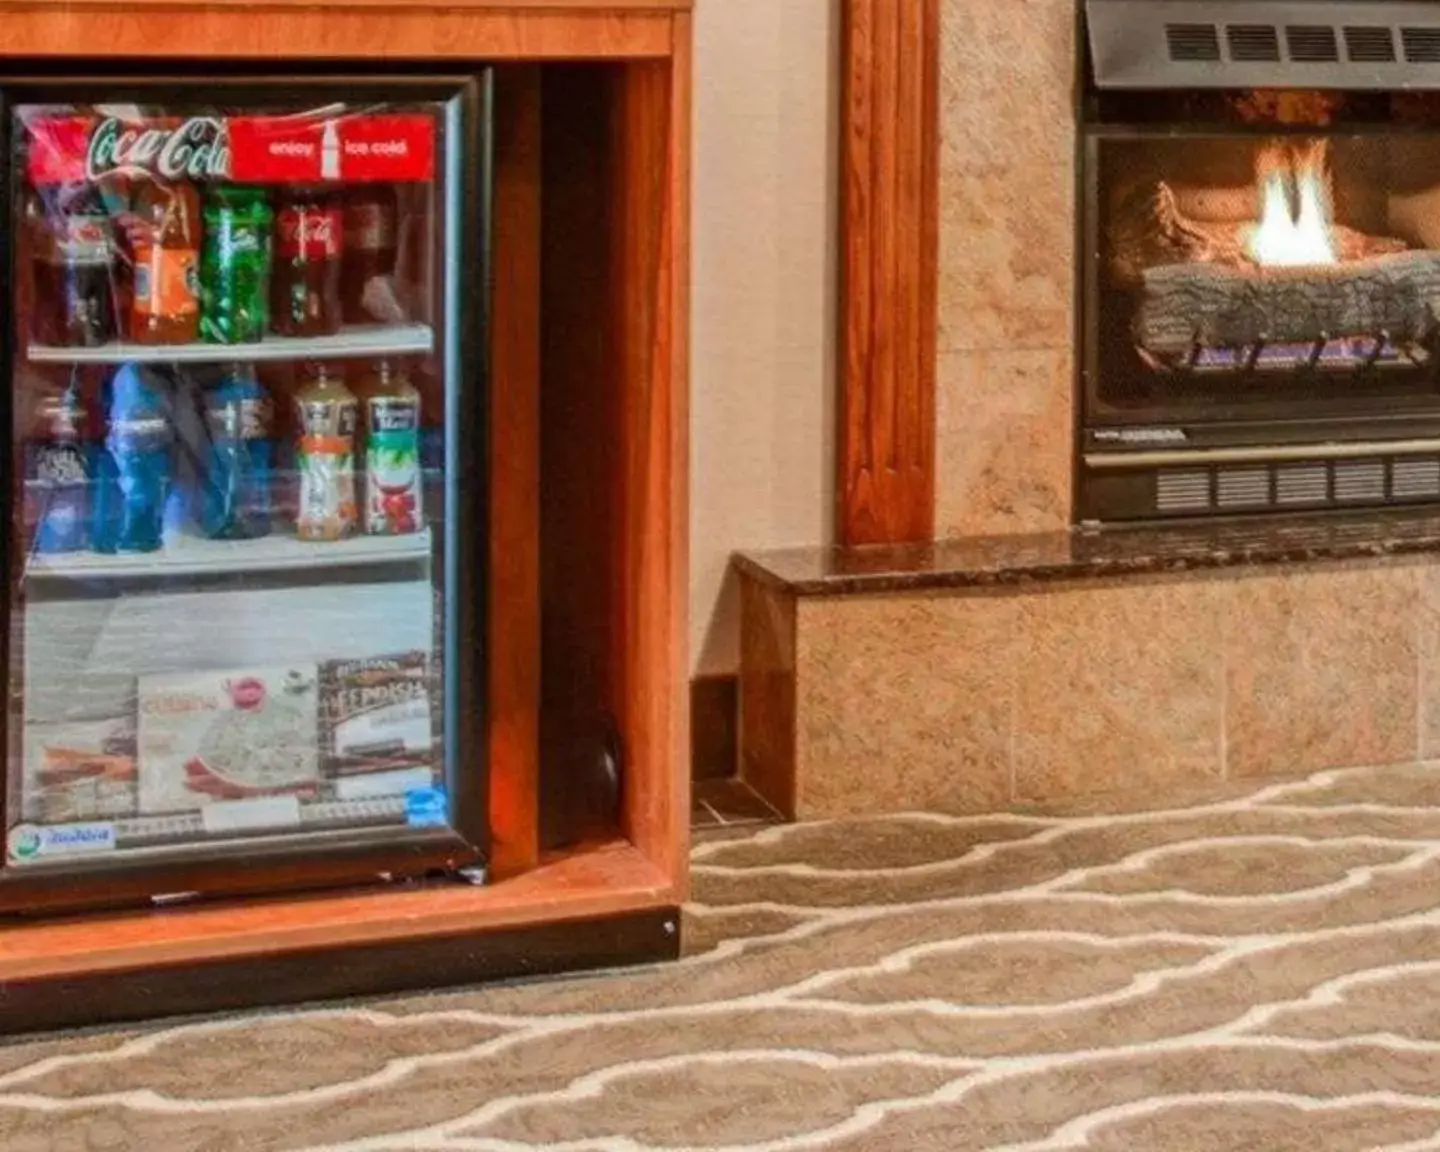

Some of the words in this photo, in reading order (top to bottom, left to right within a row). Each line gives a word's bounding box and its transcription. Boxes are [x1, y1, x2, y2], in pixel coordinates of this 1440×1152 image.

[269, 140, 314, 157] enjoy
[345, 138, 368, 155] ice
[371, 138, 407, 156] cold
